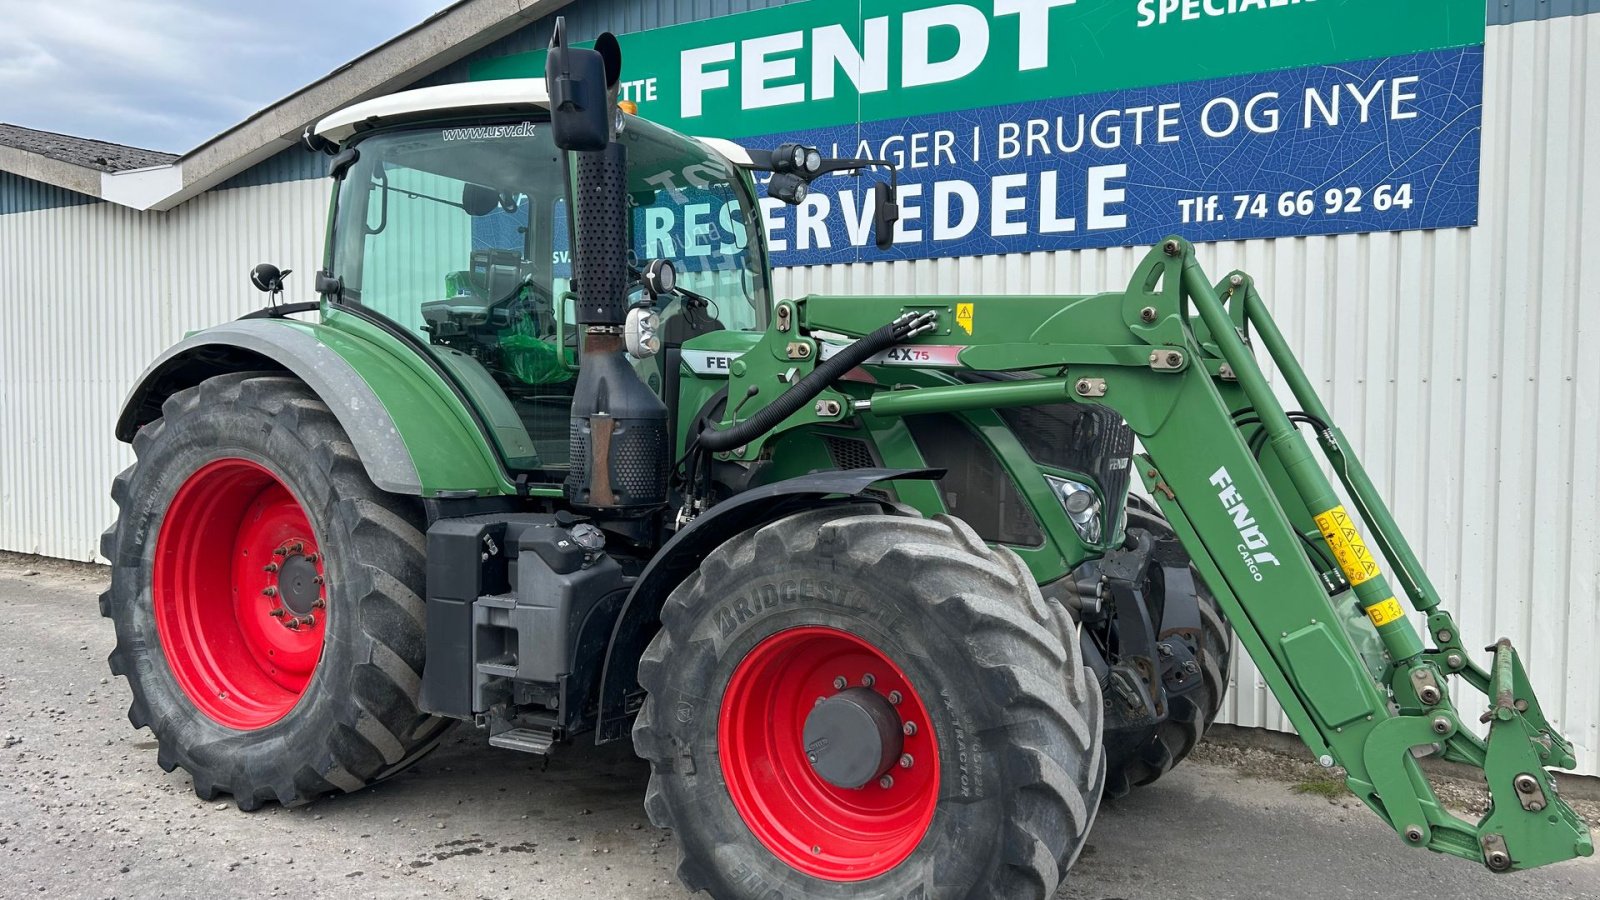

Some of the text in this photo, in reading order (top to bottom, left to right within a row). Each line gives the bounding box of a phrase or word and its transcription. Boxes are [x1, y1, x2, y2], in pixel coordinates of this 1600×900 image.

[679, 0, 1077, 118] FENDT
[442, 121, 536, 141] www.usv.dk
[831, 130, 957, 177] LAGER
[998, 102, 1181, 159] BRUGTE
[1201, 91, 1279, 138] OG
[1304, 75, 1419, 129] NYE
[645, 163, 1128, 259] RESERVEDELE
[1178, 183, 1413, 223] Tlf. 74 66 92 64
[1209, 466, 1281, 566] FENDT
[1237, 543, 1263, 582] CARGO
[711, 577, 912, 641] BRIDGESTONE
[940, 688, 970, 798] VX-TRACTOR
